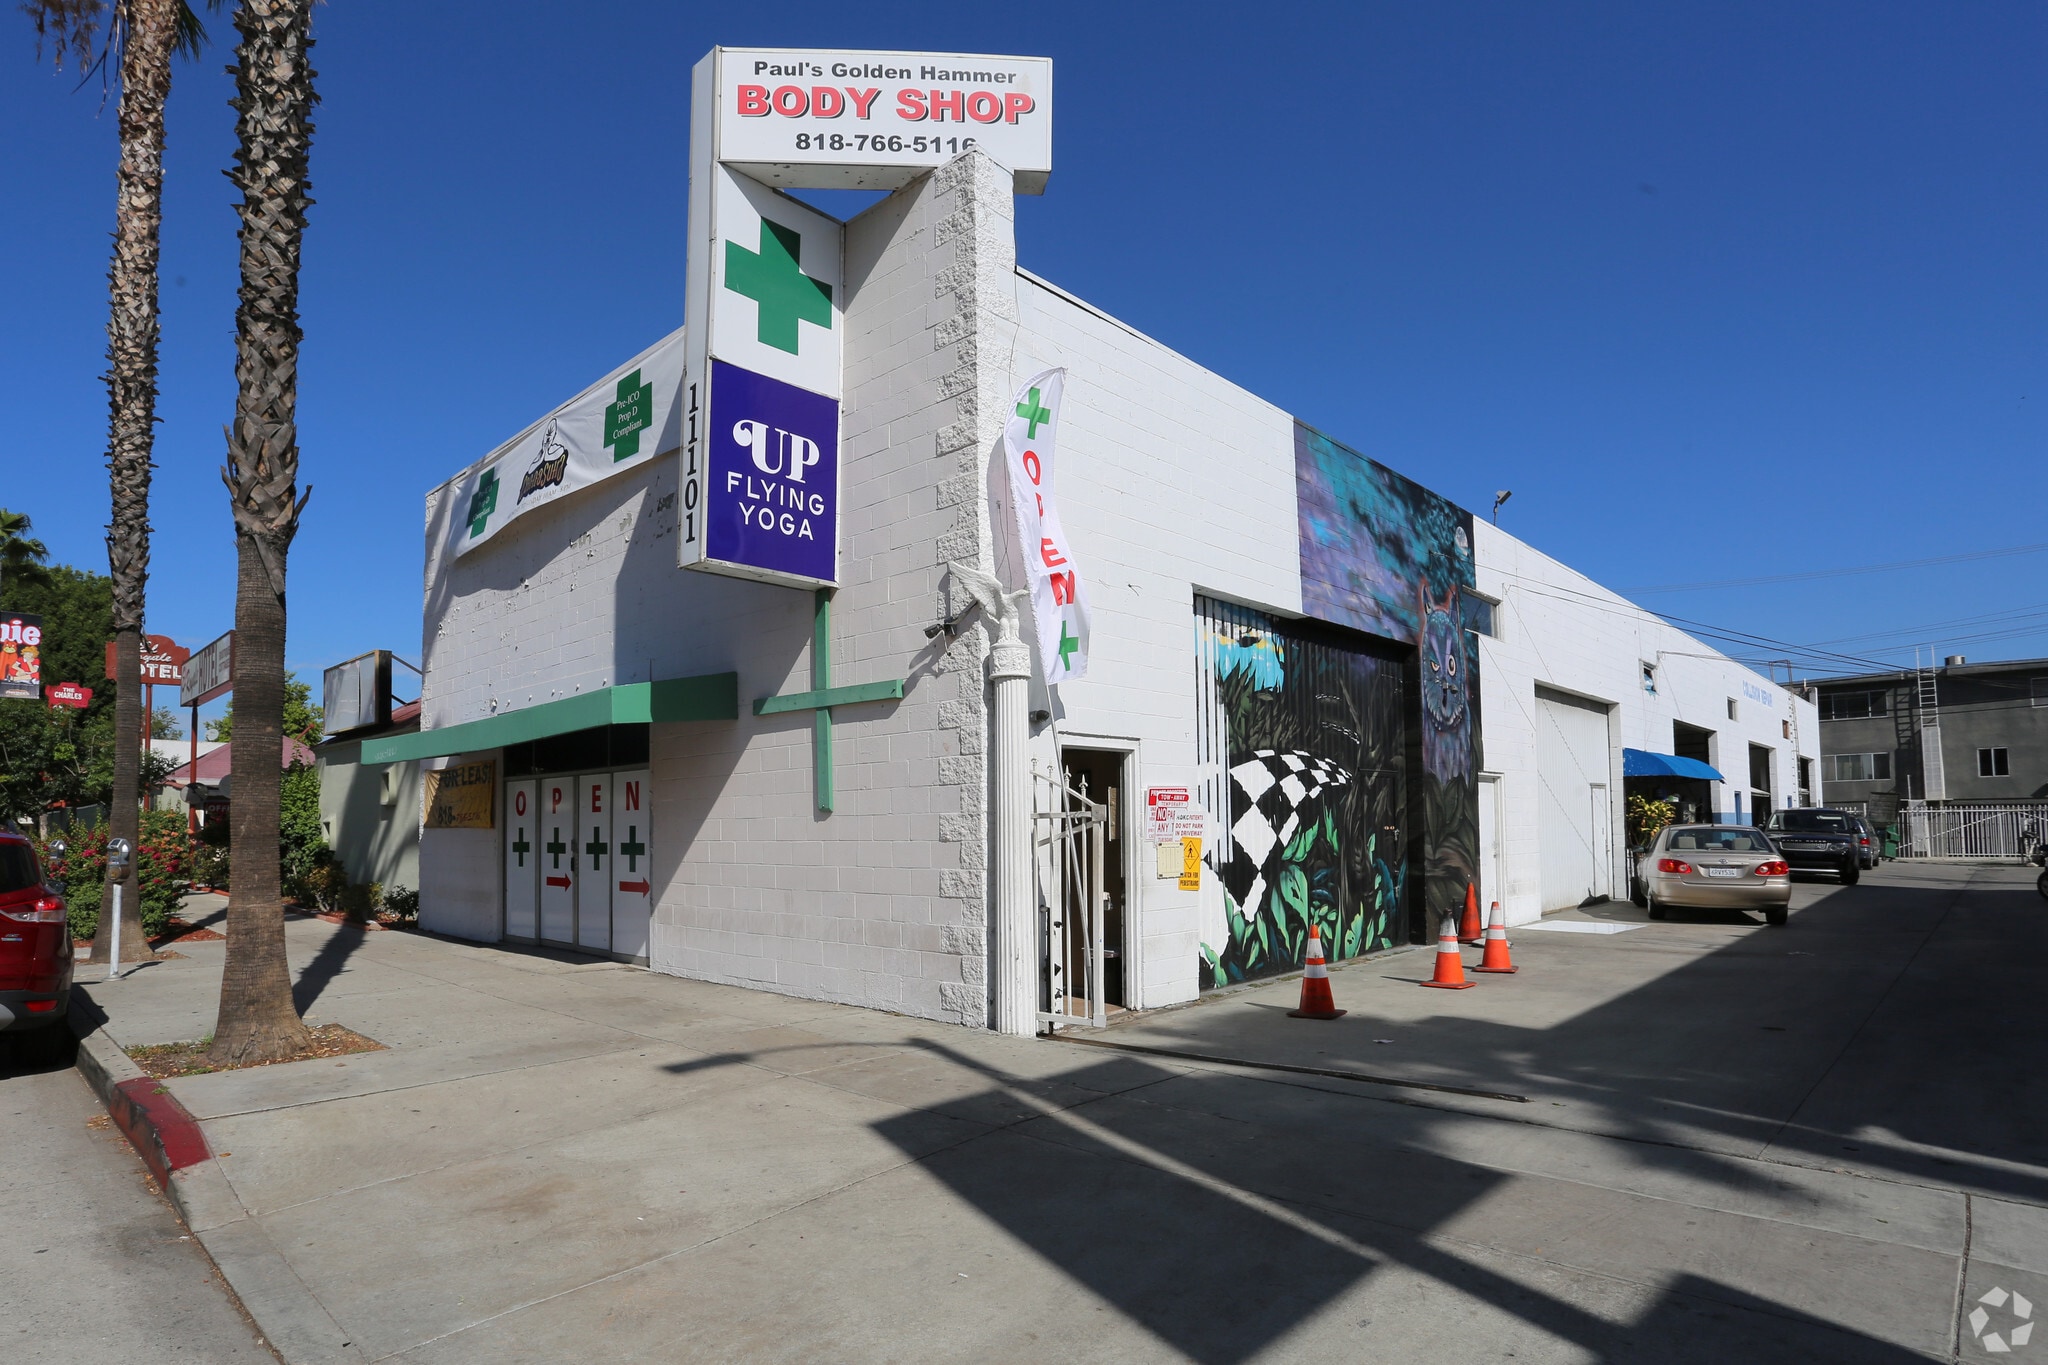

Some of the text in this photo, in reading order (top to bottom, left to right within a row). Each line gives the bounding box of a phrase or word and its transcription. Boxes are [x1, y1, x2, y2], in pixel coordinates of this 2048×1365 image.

[754, 60, 1017, 84] Paul's Golden Hammer
[737, 84, 1036, 125] BODY SHOP
[795, 132, 977, 154] 818-766-5116
[632, 405, 639, 417] D
[612, 418, 643, 440] Compliant
[684, 382, 699, 544] 11101
[732, 419, 820, 484] UP
[727, 471, 825, 516] FLYING
[738, 502, 814, 541] YOGA
[54, 691, 82, 700] CHARLES
[515, 781, 640, 816] OPEN
[1157, 808, 1167, 820] NO
[1157, 823, 1169, 832] ANY
